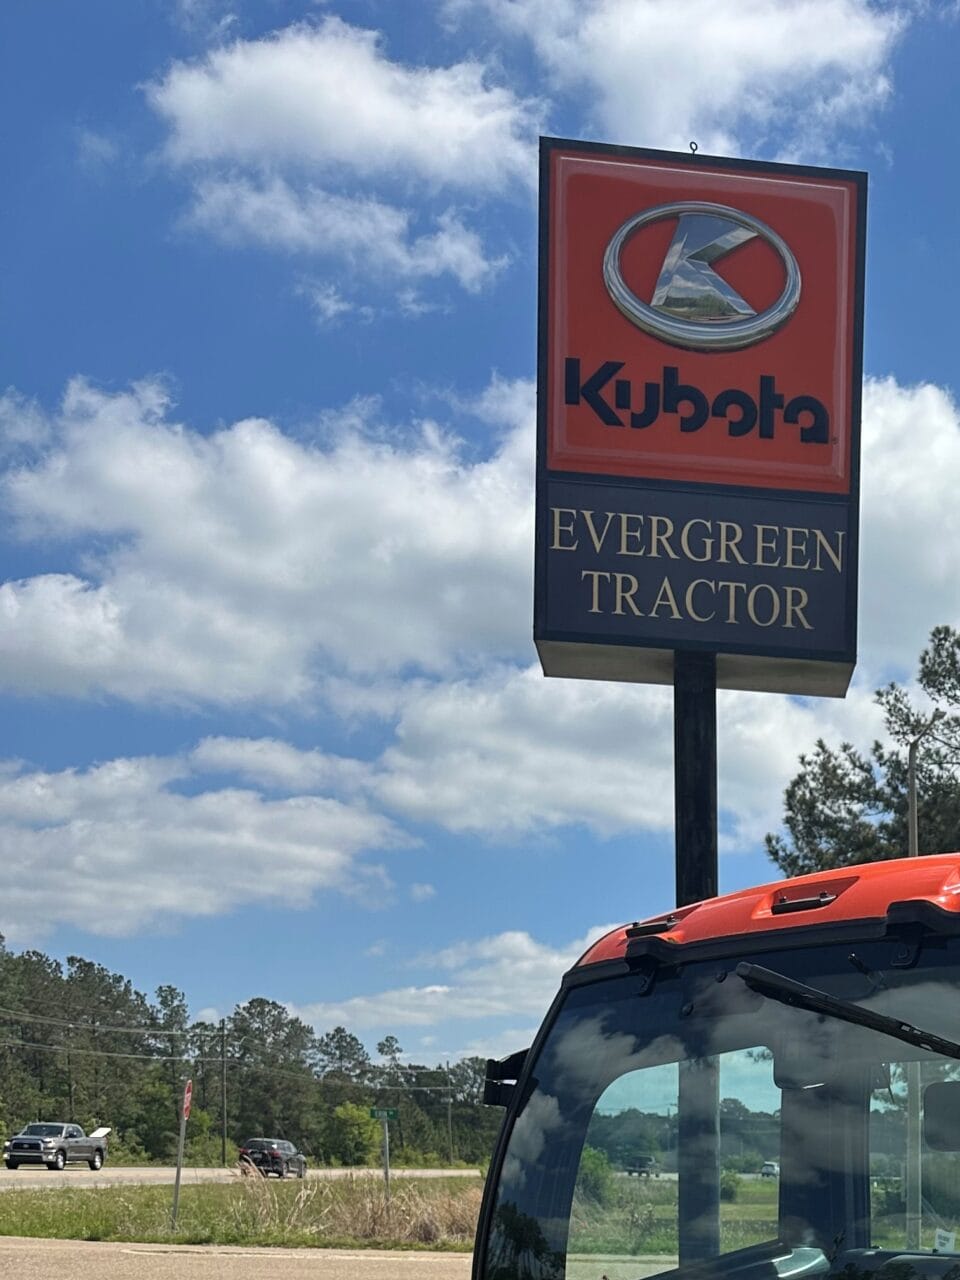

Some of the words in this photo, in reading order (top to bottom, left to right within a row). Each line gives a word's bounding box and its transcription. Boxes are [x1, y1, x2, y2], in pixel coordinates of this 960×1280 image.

[564, 357, 830, 444] Kubota
[549, 507, 847, 574] EVERGREEN
[581, 570, 814, 630] TRACTOR
